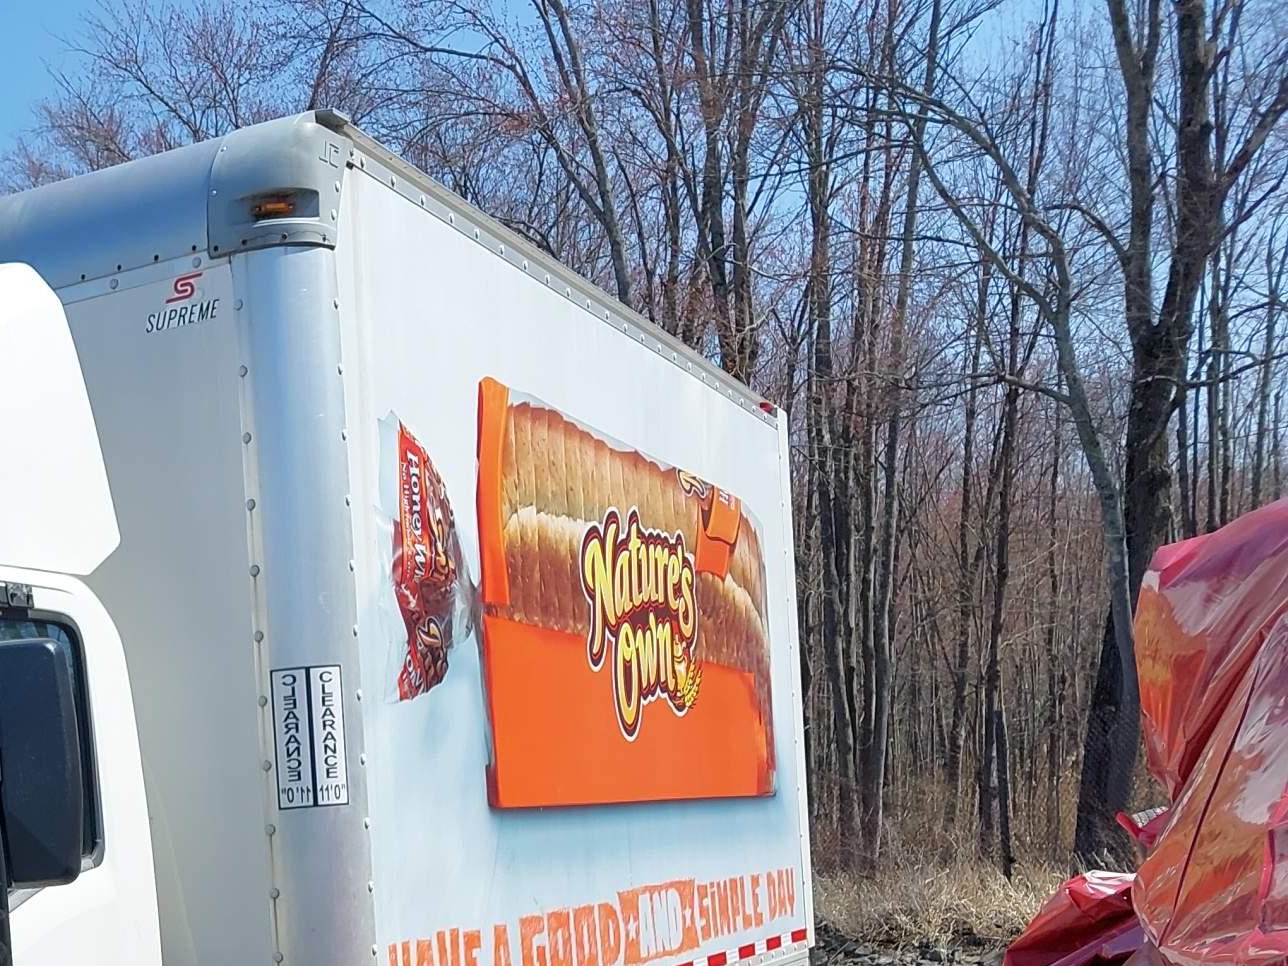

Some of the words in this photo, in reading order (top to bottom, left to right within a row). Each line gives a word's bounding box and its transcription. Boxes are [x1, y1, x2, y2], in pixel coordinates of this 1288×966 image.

[146, 299, 220, 333] SUPREME
[406, 450, 424, 541] Honey
[583, 517, 695, 660] Nature's
[616, 609, 677, 729] Own
[318, 670, 339, 779] CLEARANCE
[318, 783, 346, 803] 11'0"
[637, 886, 684, 958] AND
[766, 866, 797, 922] DAY
